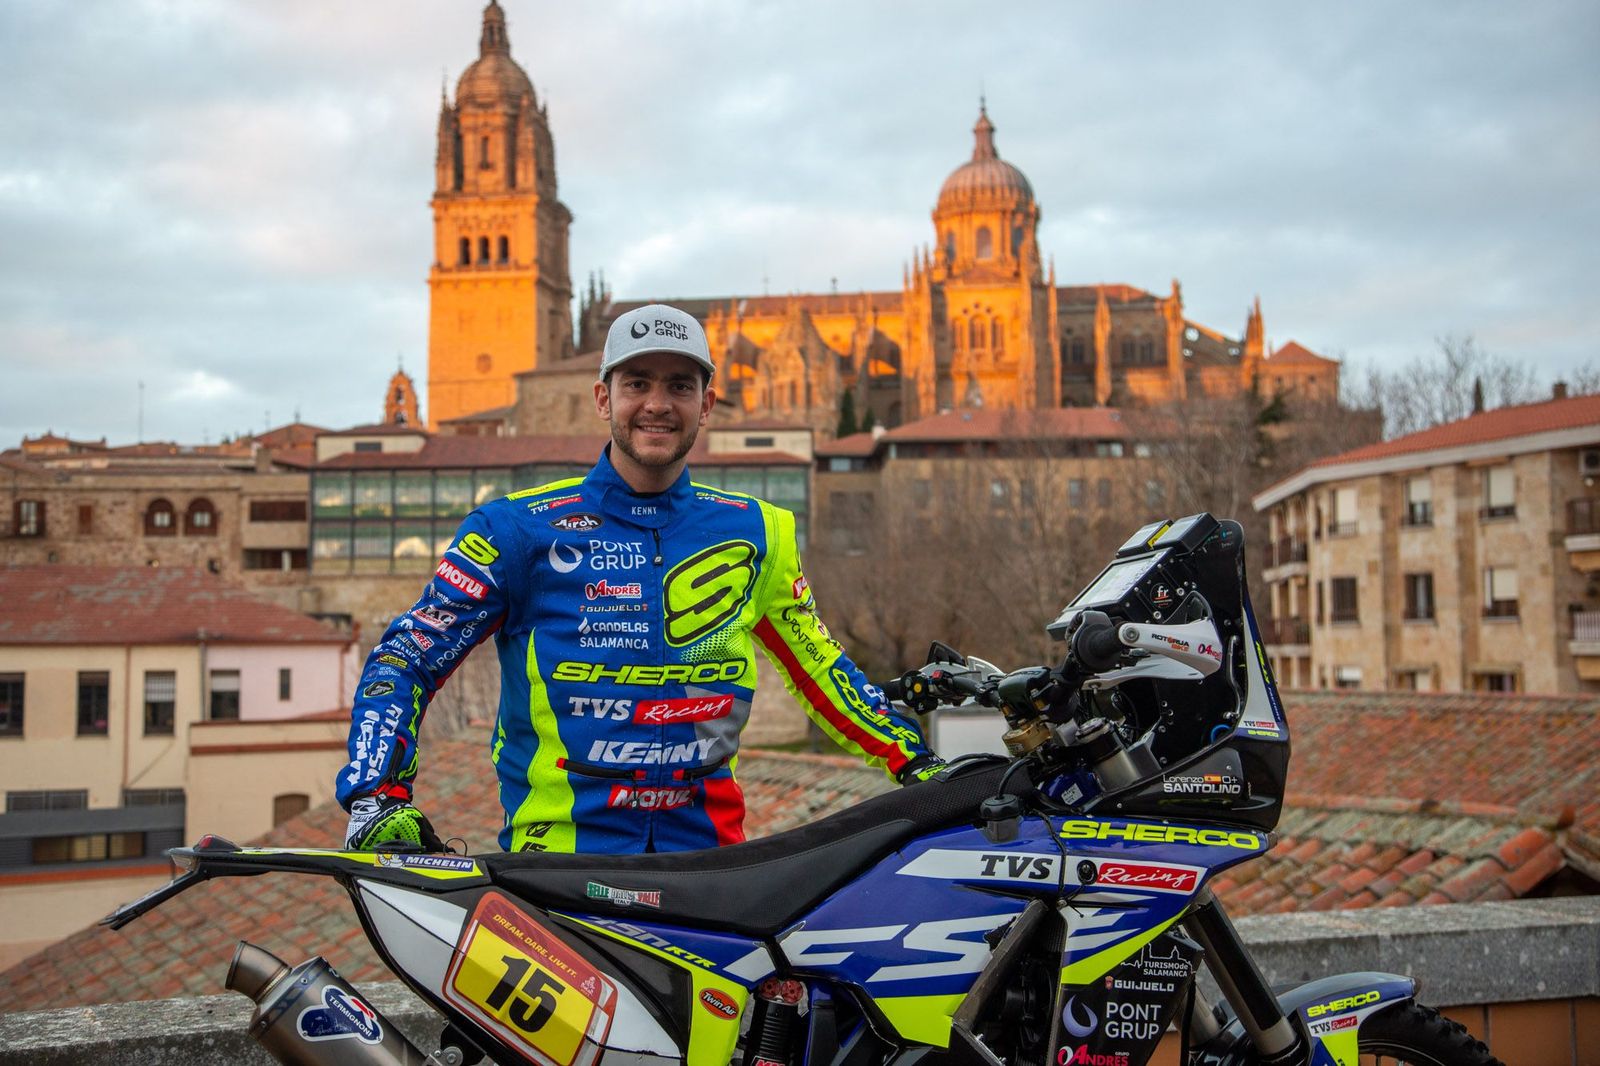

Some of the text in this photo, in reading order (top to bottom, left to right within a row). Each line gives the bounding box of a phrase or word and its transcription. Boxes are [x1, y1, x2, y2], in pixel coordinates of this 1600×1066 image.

[654, 319, 688, 333] PONT
[655, 328, 689, 341] GRUP
[530, 503, 549, 515] TVS
[631, 505, 657, 516] KENNY
[555, 515, 599, 528] Airoh
[589, 539, 643, 553] PONT
[590, 554, 647, 570] GRUP
[436, 560, 485, 600] MOTUL
[586, 604, 641, 613] GUIJUELO
[592, 622, 650, 633] CANDELAS
[579, 637, 649, 650] SALAMANCA
[436, 638, 467, 669] PONT
[551, 660, 748, 686] SHERCO
[569, 696, 732, 722] TVS Racing
[587, 736, 721, 764] KENNY
[1163, 774, 1204, 783] Lorenzo
[1163, 783, 1241, 794] SANTOLINO
[612, 789, 691, 809] MOTUL
[1060, 819, 1260, 850] SHERCO
[405, 856, 473, 869] MICHELIN
[980, 855, 1196, 889] TVS Racing
[493, 914, 578, 978] DREAM. DARE. LIVE IT.
[1143, 968, 1188, 978] SALAMANCA
[1114, 979, 1175, 992] GUIJUELO
[485, 954, 567, 1034] 15
[702, 991, 737, 1018] Twin Air
[1106, 1002, 1162, 1021] PONT
[1306, 990, 1381, 1018] SHERCO
[328, 996, 373, 1037] TERMIGNONI
[1105, 1021, 1160, 1040] GRUP
[1310, 1018, 1356, 1034] TVS Racing
